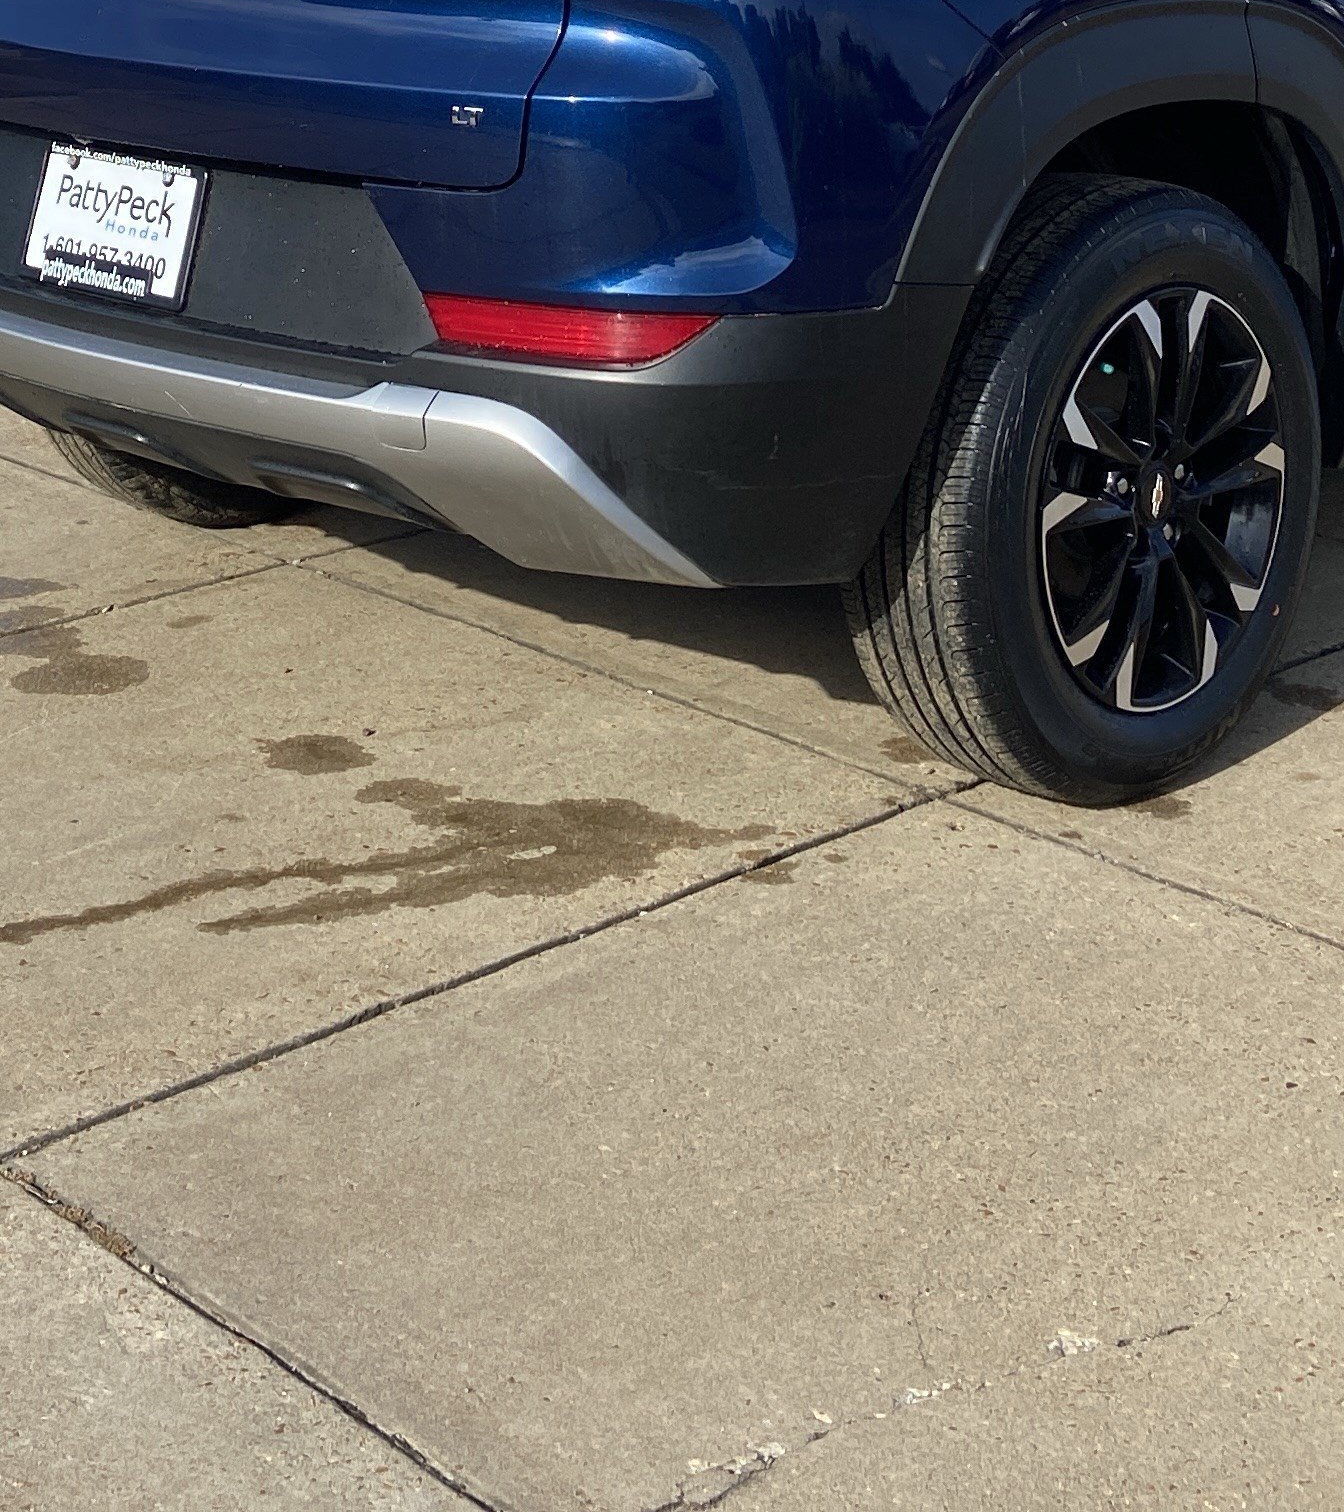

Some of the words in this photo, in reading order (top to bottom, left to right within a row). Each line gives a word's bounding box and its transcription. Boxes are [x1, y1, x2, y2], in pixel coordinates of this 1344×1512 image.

[451, 105, 484, 128] LT
[51, 141, 192, 177] facebook.com/pattypeckhonda
[56, 173, 175, 238] PattyPeck
[105, 218, 159, 242] Honda
[39, 257, 147, 298] pattypeckhonda.com
